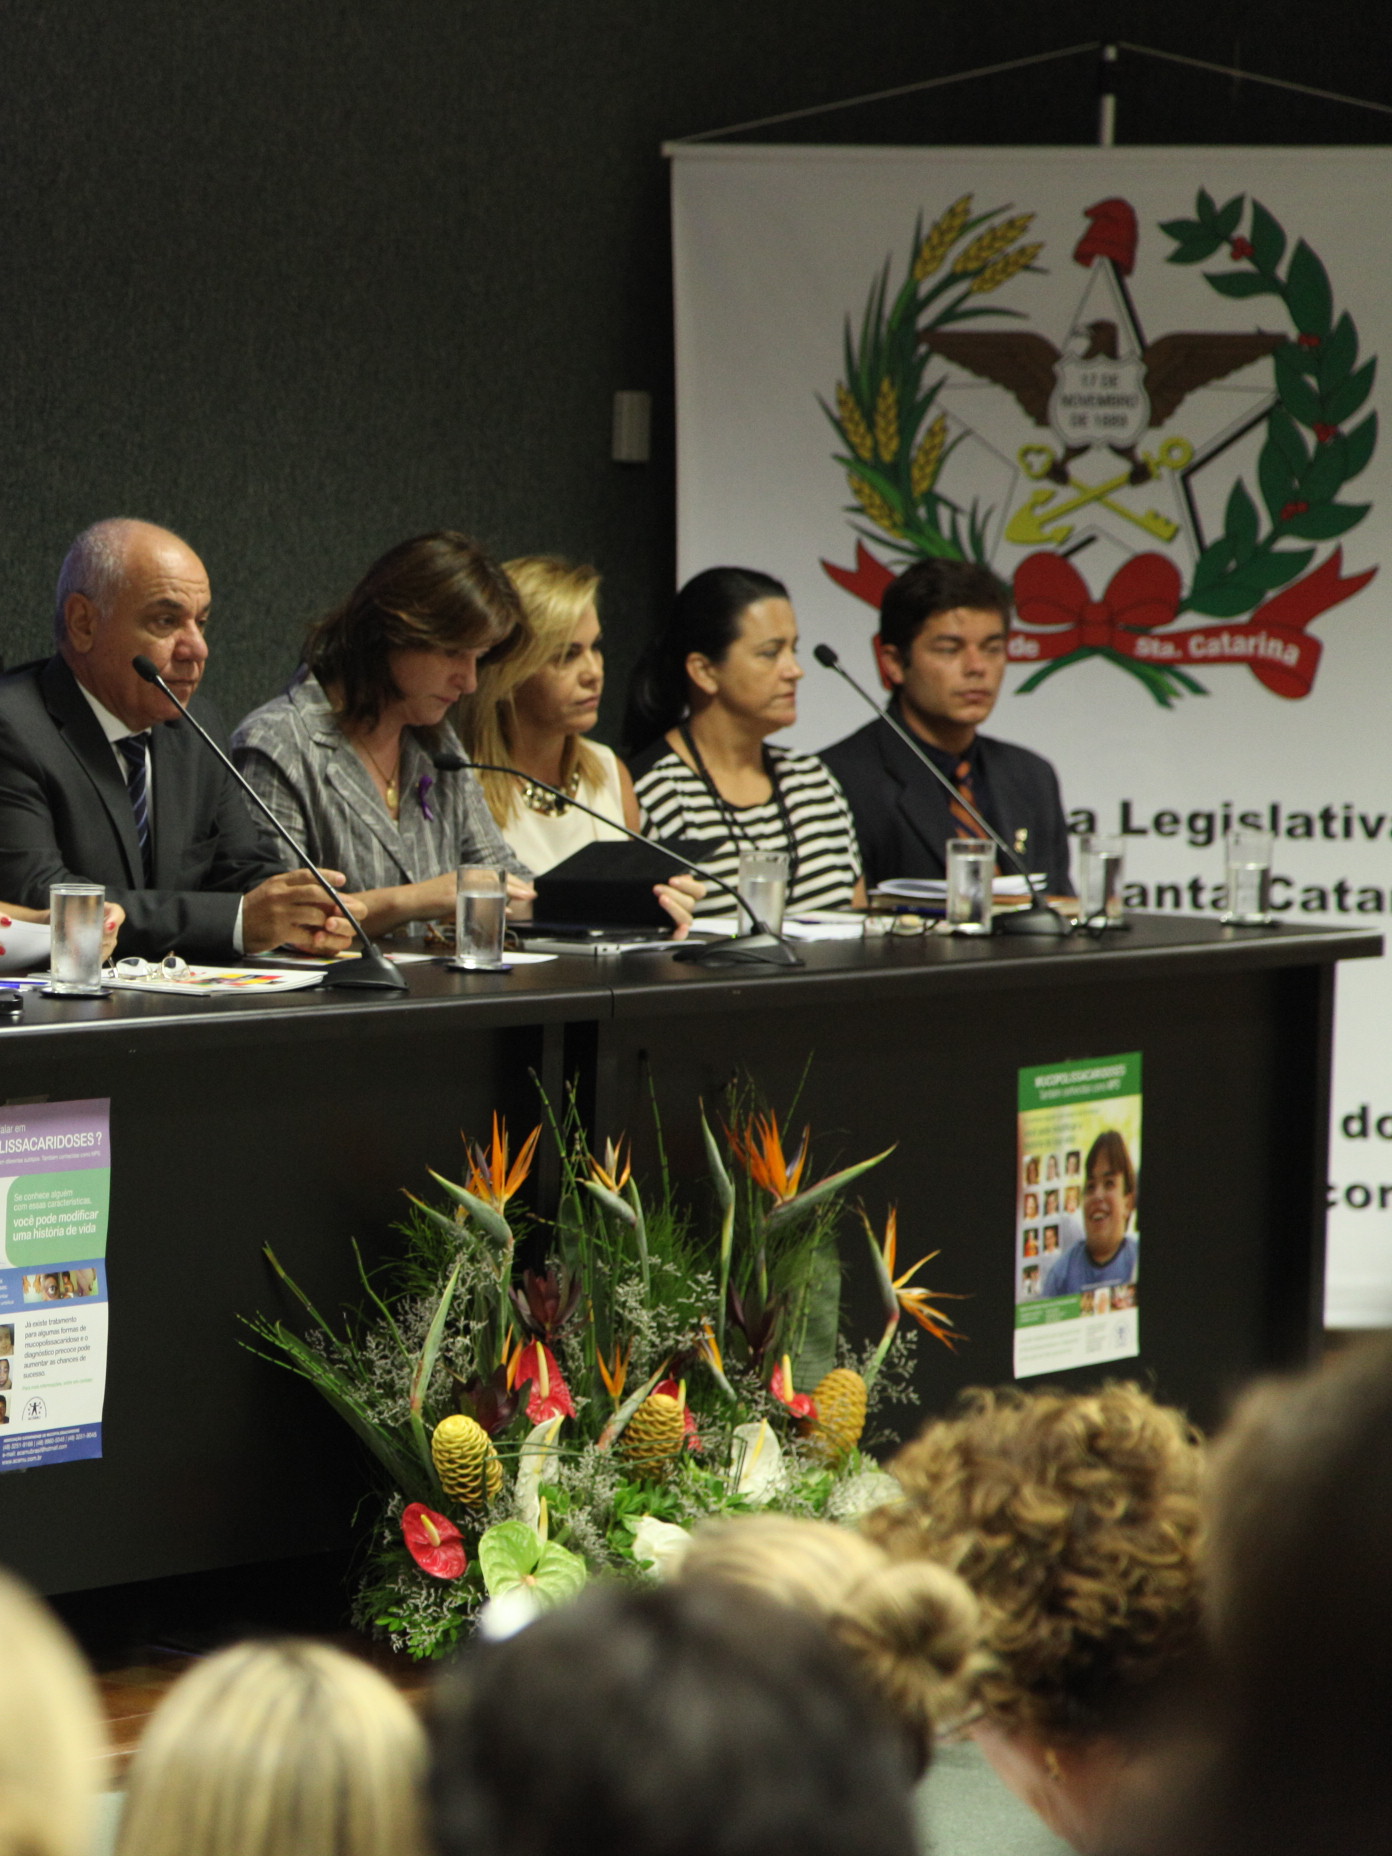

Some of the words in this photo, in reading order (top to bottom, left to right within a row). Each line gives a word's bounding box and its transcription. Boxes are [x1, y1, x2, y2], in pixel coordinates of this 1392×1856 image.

[1009, 636, 1039, 658] de
[1135, 637, 1183, 658] Sta.
[1188, 631, 1300, 667] Catarina
[1121, 800, 1392, 847] Legislativ
[1123, 876, 1229, 910] anta
[1269, 877, 1392, 912] Cata
[15, 1125, 25, 1133] em
[14, 1193, 22, 1201] Se
[24, 1192, 49, 1200] conhece
[51, 1189, 72, 1199] alguém
[14, 1203, 27, 1211] com
[14, 1215, 34, 1227] você
[36, 1213, 57, 1228] pode
[59, 1210, 99, 1222] modificar
[13, 1231, 31, 1241] uma
[34, 1226, 64, 1238] história
[66, 1225, 77, 1235] de
[79, 1223, 96, 1234] vida
[49, 1317, 77, 1325] tratamento
[38, 1330, 60, 1338] algumas
[55, 1347, 76, 1355] precoce
[77, 1345, 90, 1353] pode
[24, 1360, 48, 1368] aumentar
